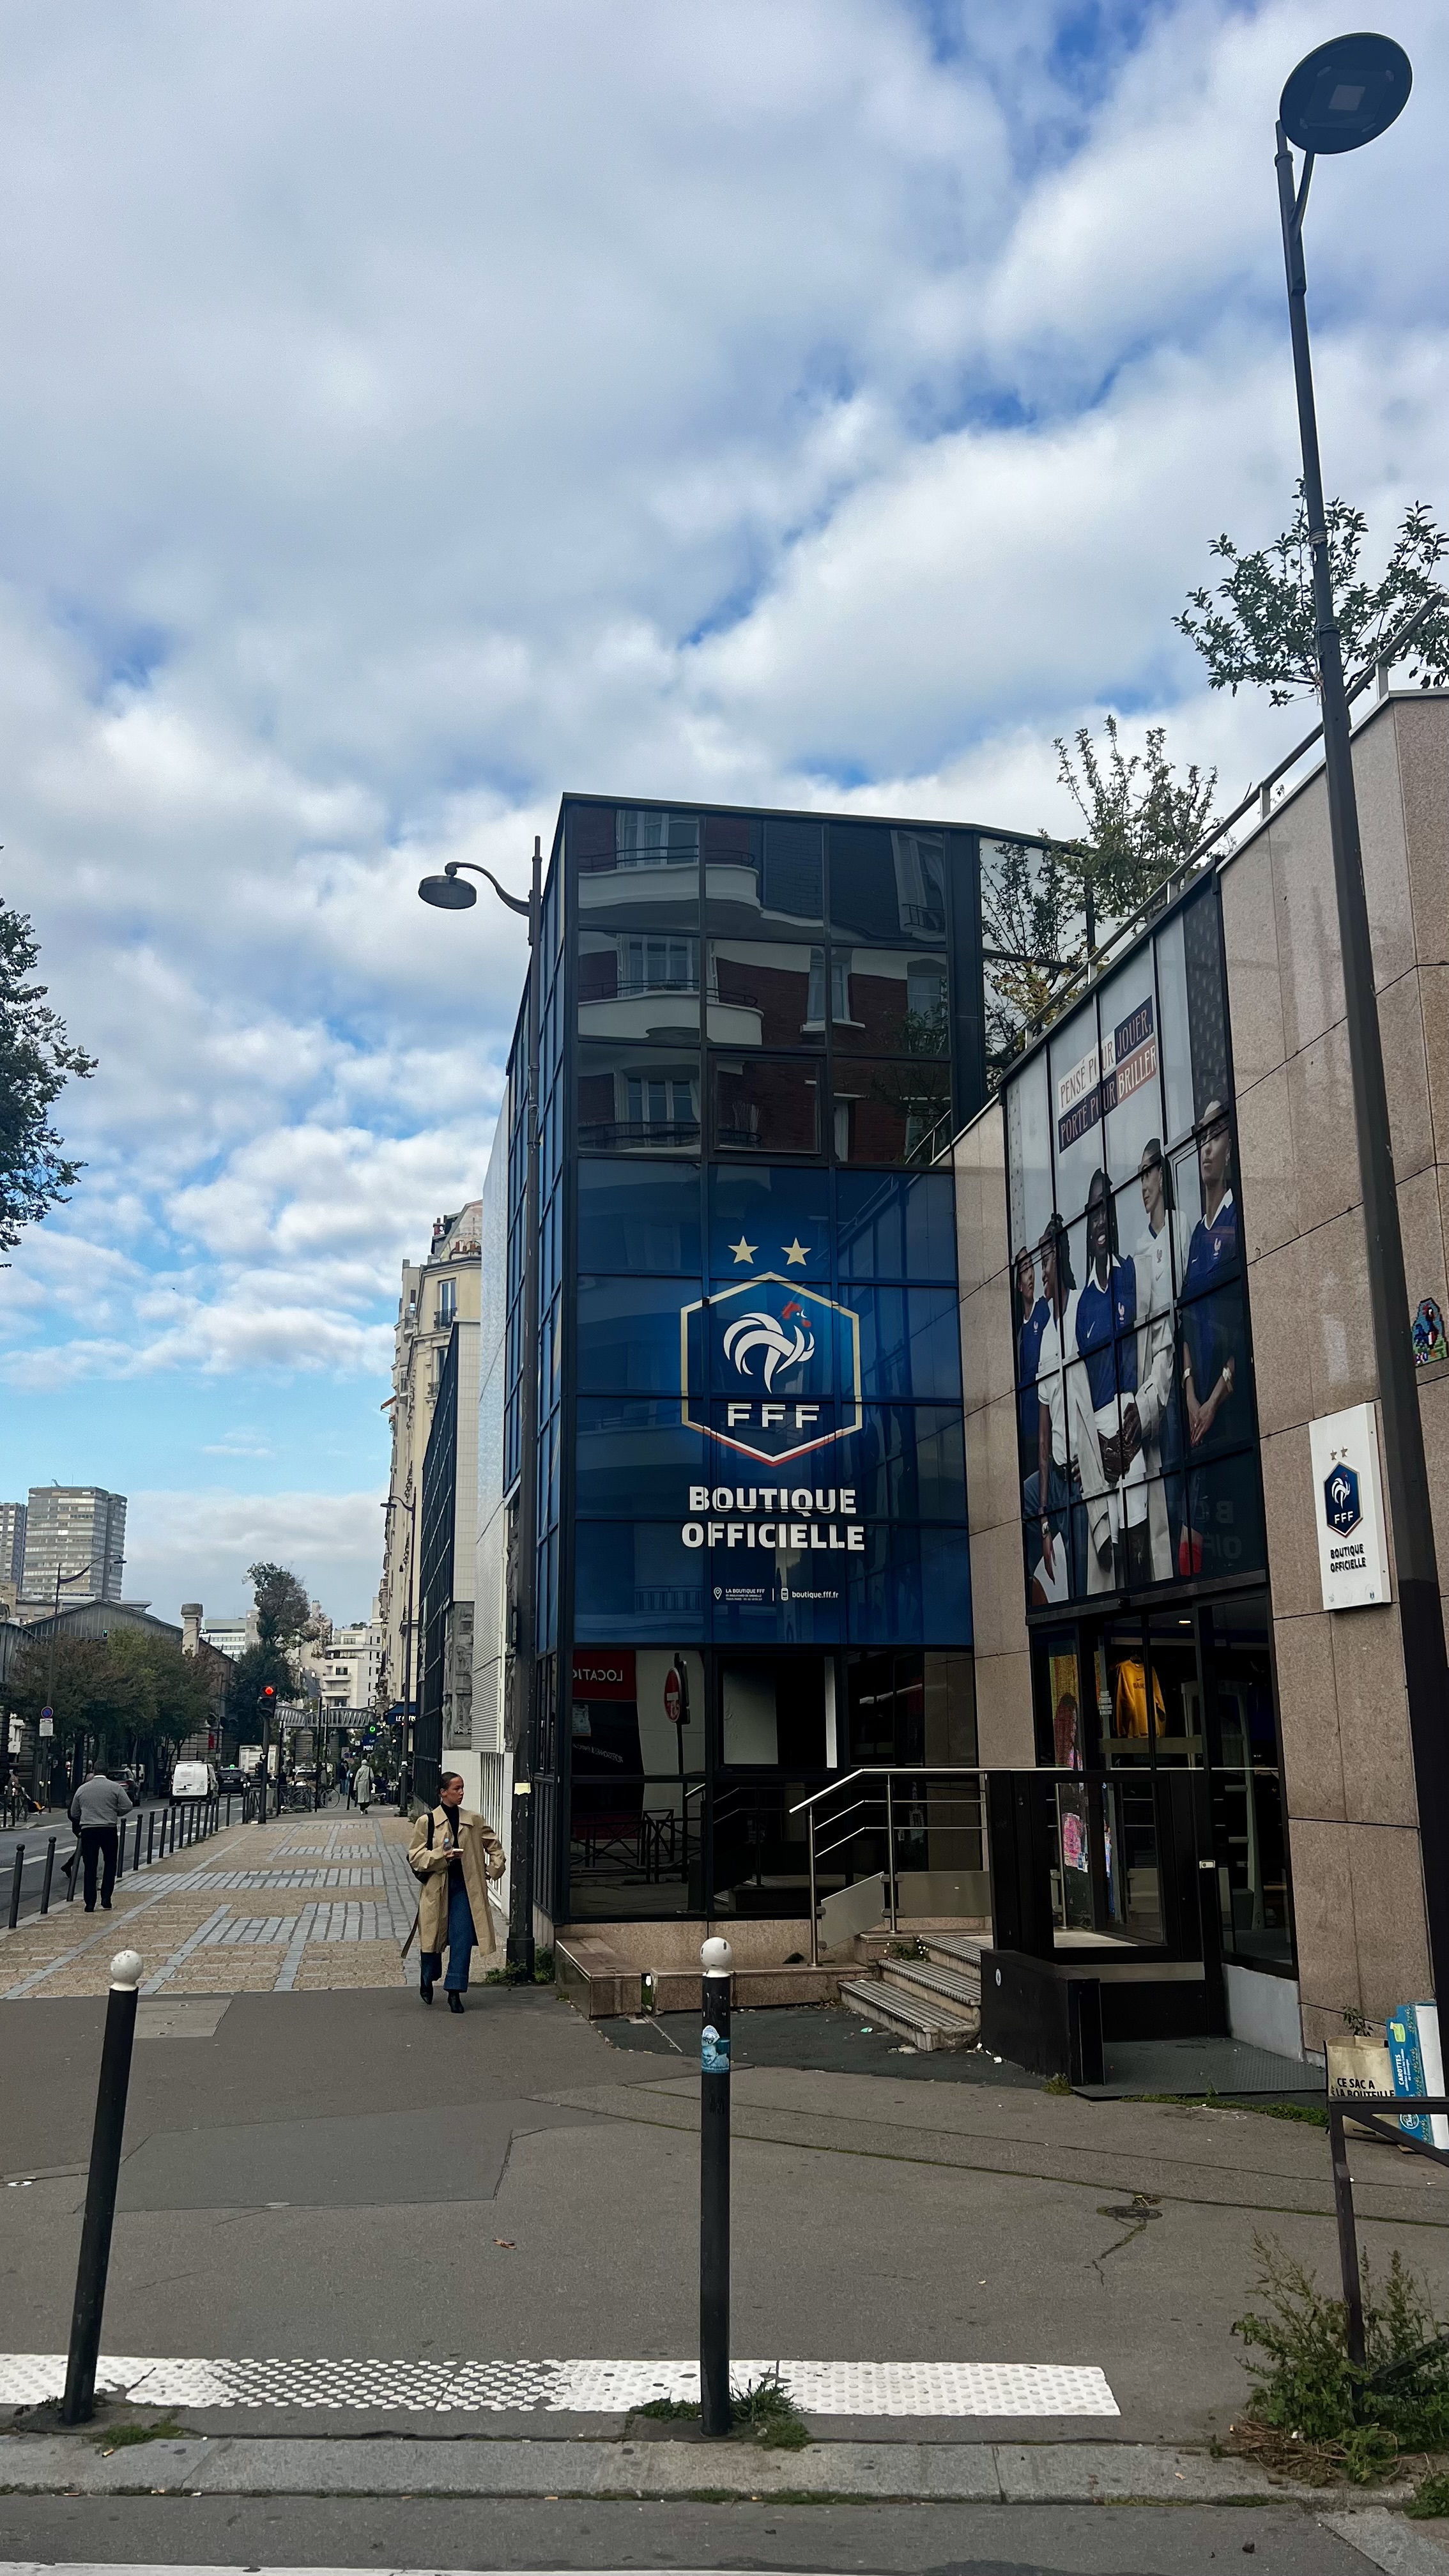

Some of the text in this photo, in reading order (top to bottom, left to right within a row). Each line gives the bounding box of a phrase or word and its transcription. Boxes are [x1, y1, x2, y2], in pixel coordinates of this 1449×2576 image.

[1060, 1059, 1086, 1108] PENSÉ
[1117, 1009, 1152, 1058] JOUER,
[1061, 1098, 1087, 1147] PORTÉ
[1117, 1045, 1157, 1100] BRILLER
[728, 1403, 820, 1429] FFF
[689, 1486, 857, 1517] BOUTIQUE
[1334, 1510, 1354, 1524] FFF
[682, 1521, 865, 1551] OFFICIELLE
[1330, 1543, 1365, 1560] BOUTIQUE
[1330, 1557, 1367, 1573] OFFICIELLE
[792, 1591, 839, 1599] boutique.fff.fr
[1395, 2054, 1405, 2085] CAROTTES
[1337, 2077, 1376, 2089] CE SAC A
